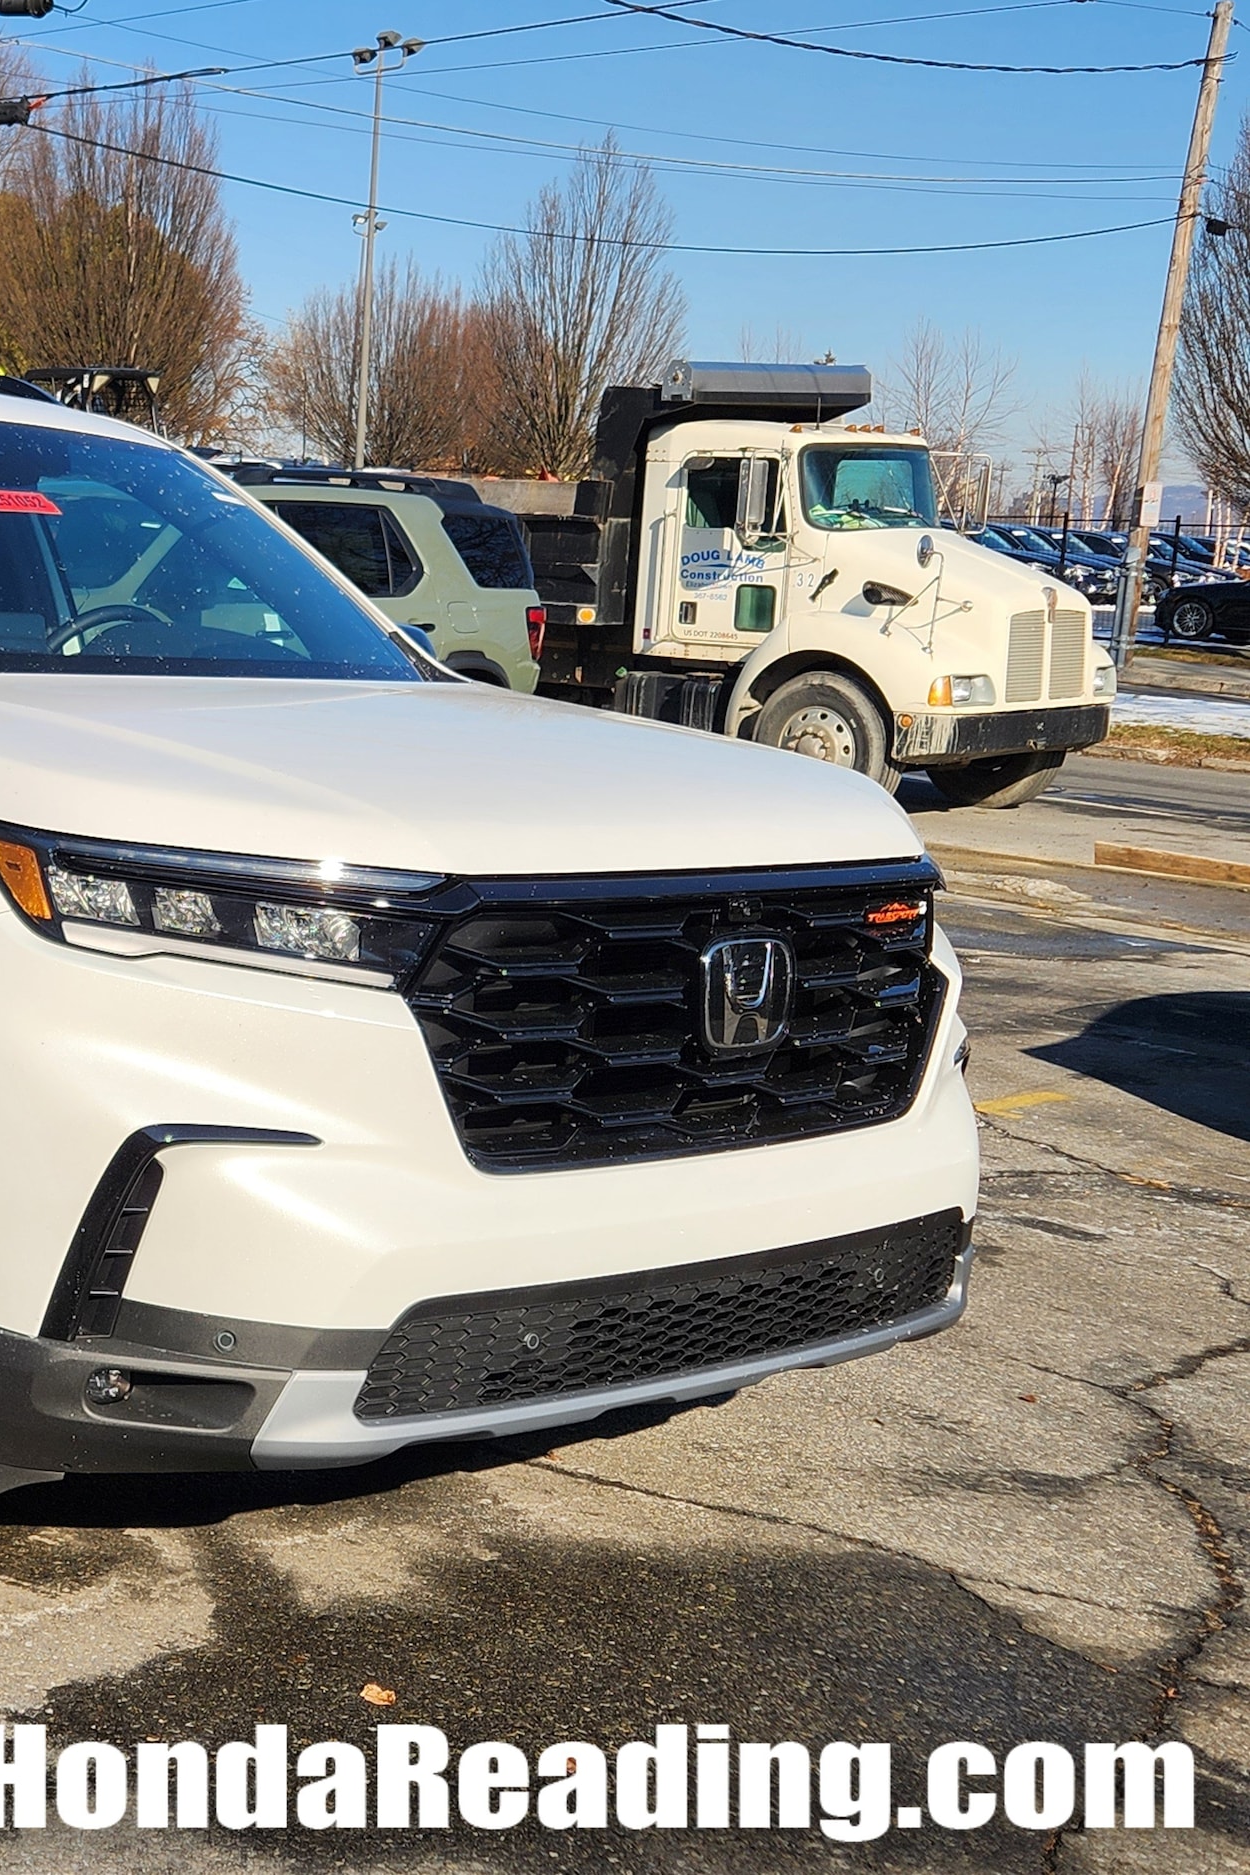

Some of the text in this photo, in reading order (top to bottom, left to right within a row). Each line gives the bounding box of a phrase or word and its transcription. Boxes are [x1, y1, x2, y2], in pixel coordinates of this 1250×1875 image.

[681, 550, 765, 569] DOUG LAMB
[680, 569, 764, 583] Construction
